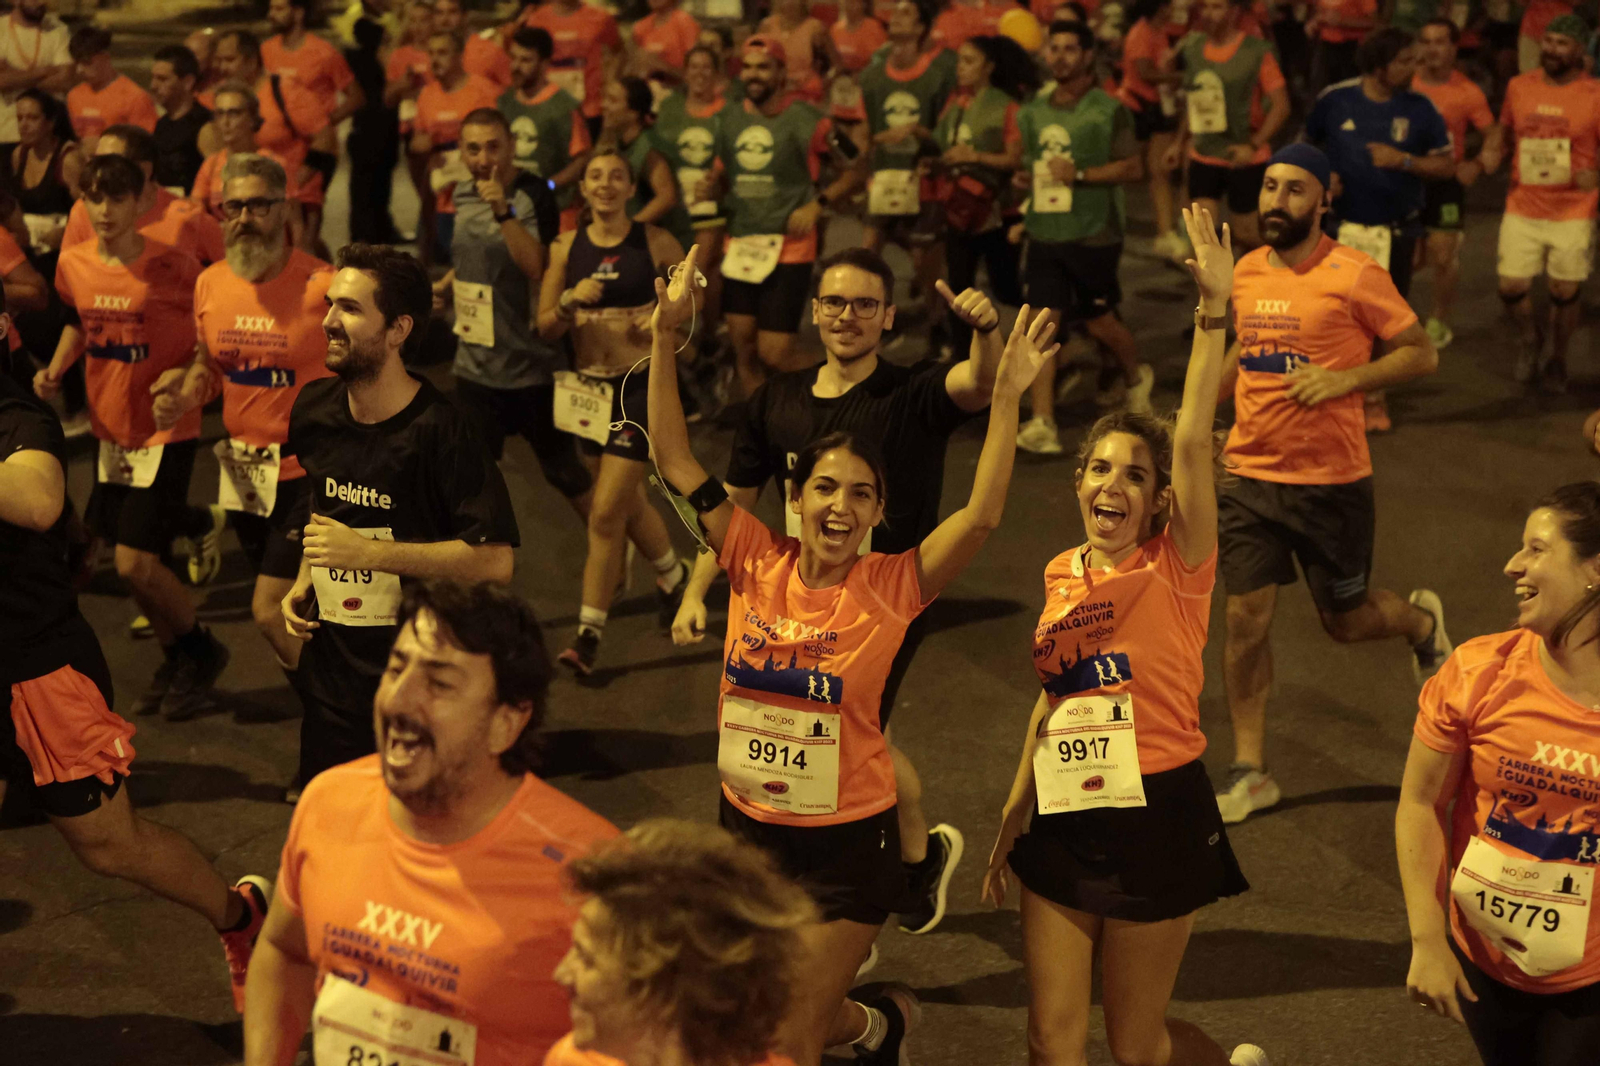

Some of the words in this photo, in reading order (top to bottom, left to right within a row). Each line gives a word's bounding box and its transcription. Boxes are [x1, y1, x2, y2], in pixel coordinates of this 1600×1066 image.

[94, 295, 131, 310] XXXV
[1255, 300, 1292, 313] XXXV
[235, 315, 275, 332] XXXV
[325, 477, 392, 510] Deloitte
[748, 739, 807, 770] 9914
[1058, 737, 1110, 763] 9917
[1499, 756, 1554, 779] CARRERA
[357, 900, 444, 949] XXXV
[1475, 890, 1560, 932] 15779
[331, 941, 458, 994] GUADALQUIVIR
